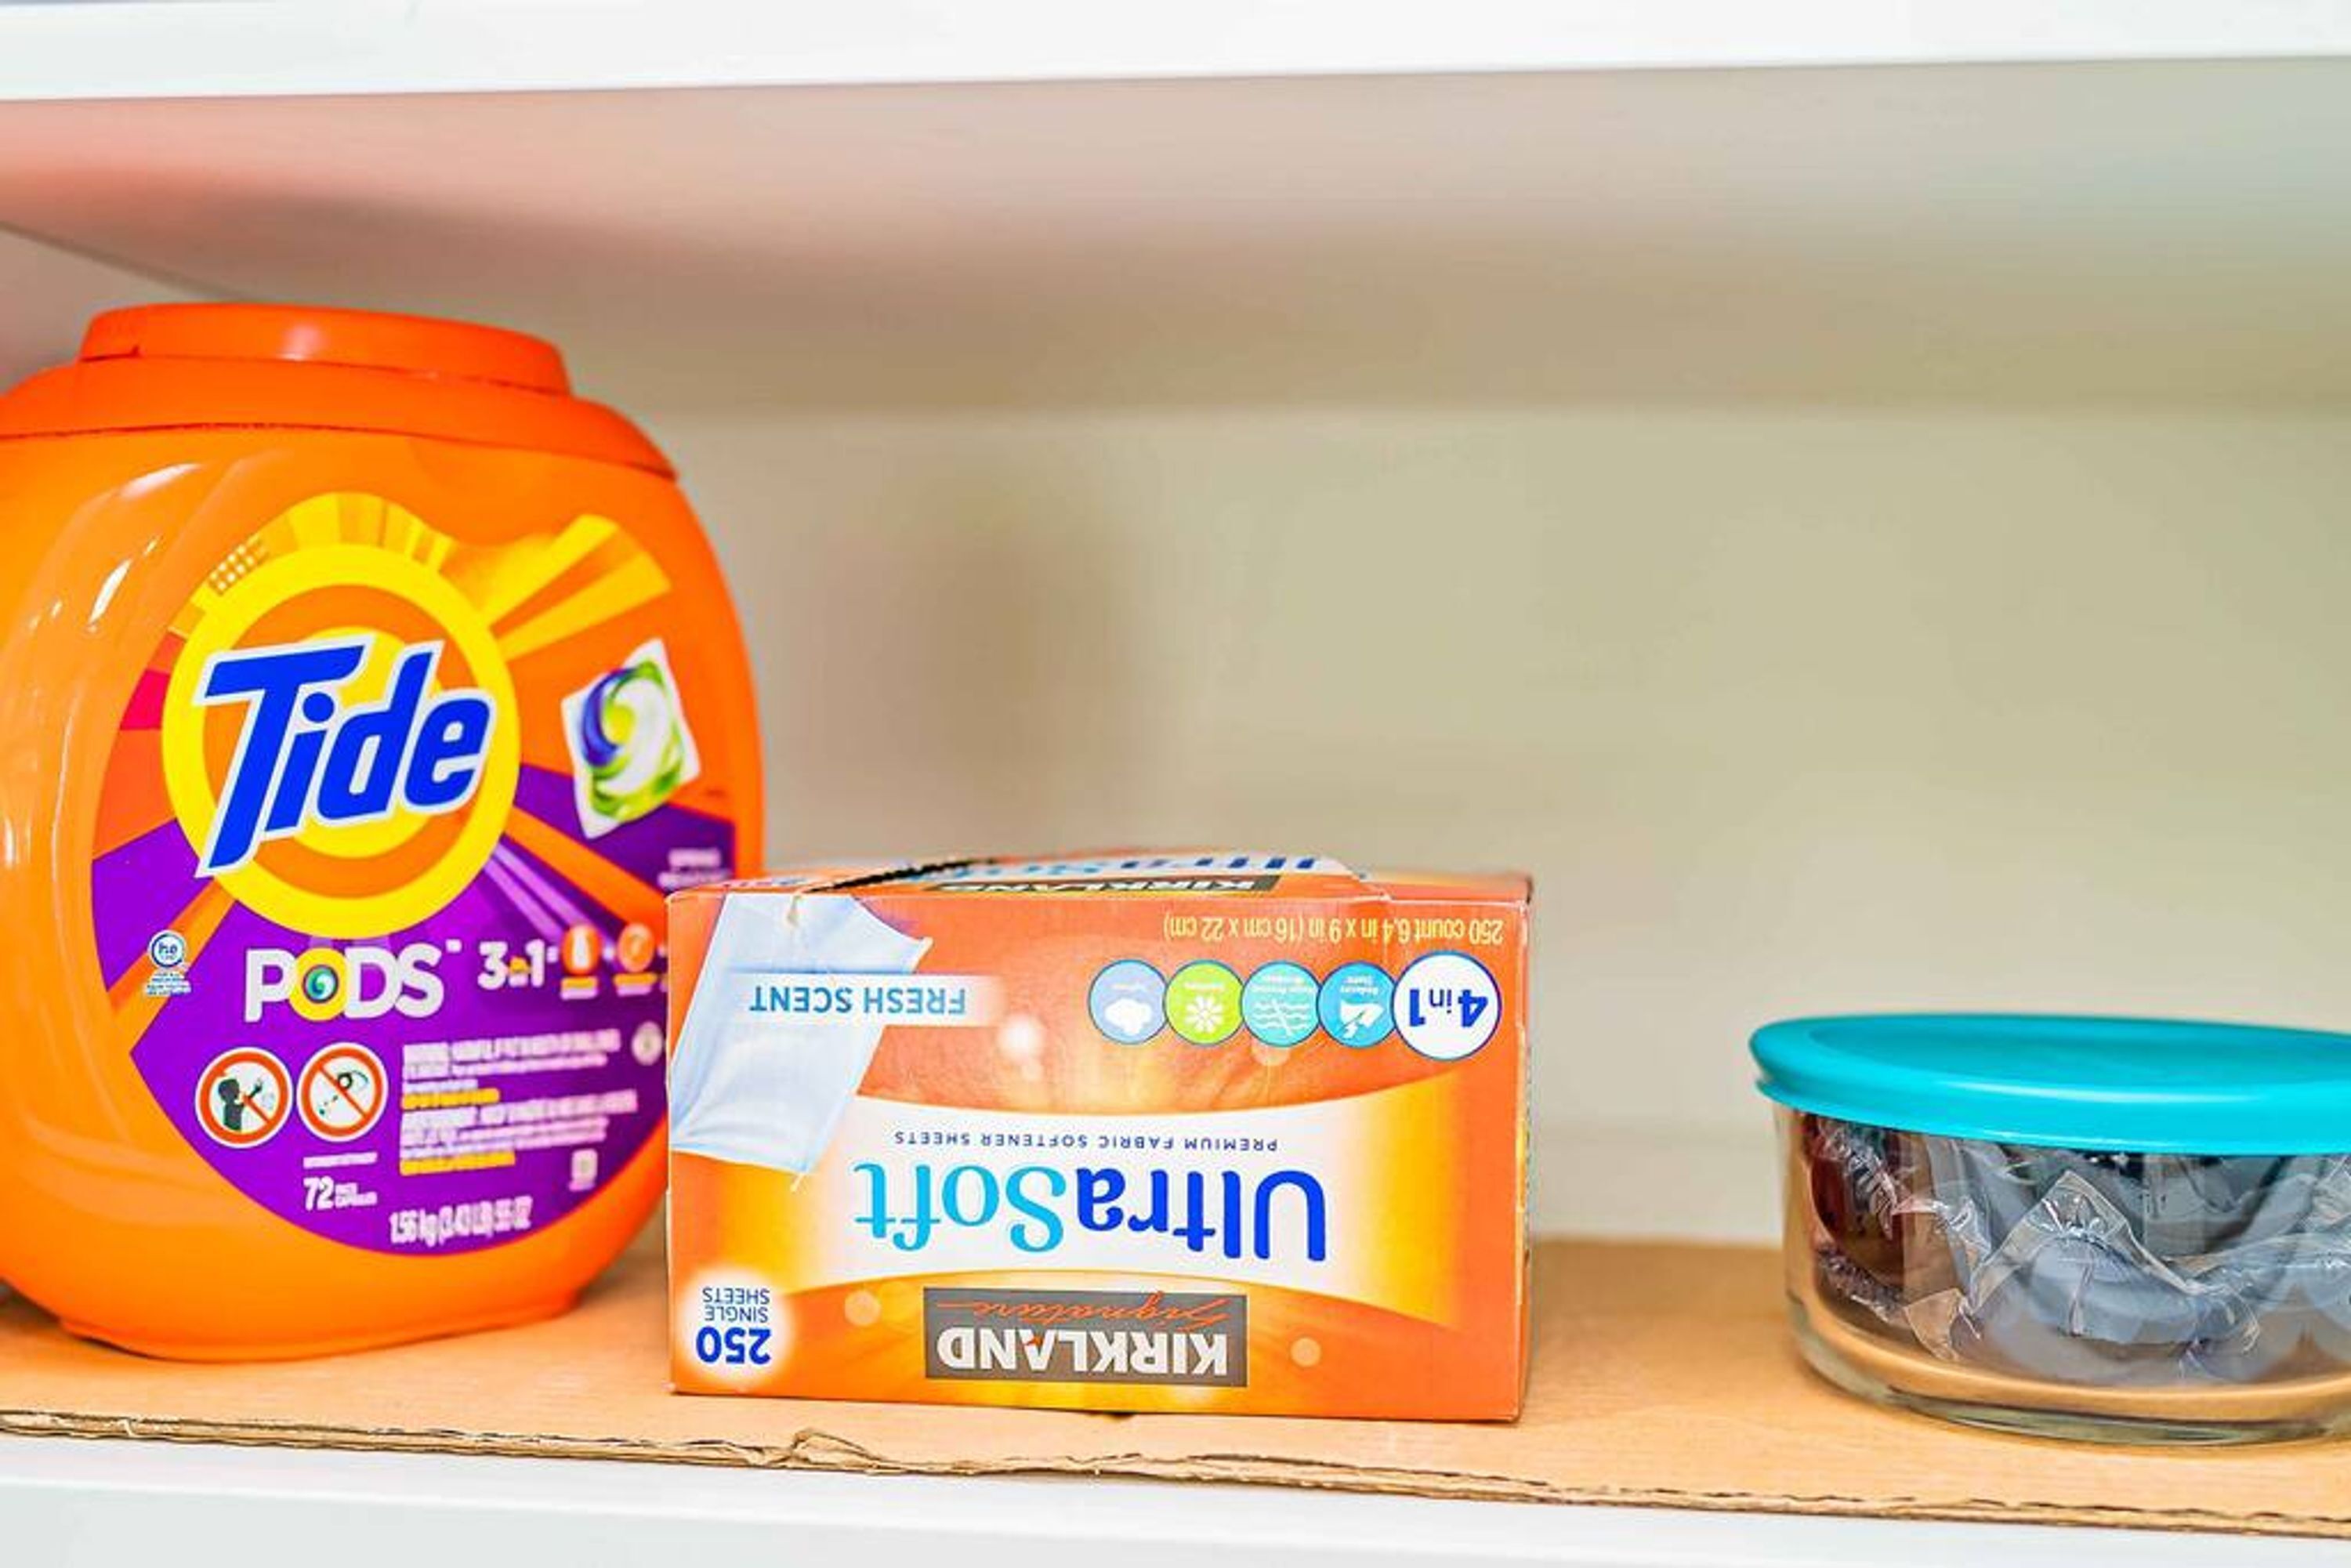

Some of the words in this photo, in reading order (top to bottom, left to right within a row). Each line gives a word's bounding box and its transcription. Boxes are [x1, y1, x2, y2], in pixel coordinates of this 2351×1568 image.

[197, 633, 495, 878] Tide
[1162, 914, 1197, 941] cm)
[1201, 917, 1223, 941] 22
[1230, 918, 1240, 935] x
[1244, 918, 1271, 935] cm
[1275, 916, 1304, 942] (16
[1308, 918, 1325, 942] in
[1331, 918, 1342, 942] 9
[1347, 918, 1357, 935] x
[1360, 918, 1378, 942] in
[1382, 918, 1411, 943] 6.4
[1415, 918, 1466, 943] count
[1469, 918, 1504, 943] 250
[245, 943, 444, 1023] PODS
[748, 986, 853, 1014] SCENT
[863, 987, 967, 1016] FRESH
[893, 1132, 970, 1146] SHEETS
[980, 1134, 1088, 1149] SOFTENER
[1098, 1135, 1174, 1150] FABRIC
[1183, 1138, 1278, 1152] PREMIUM
[303, 1175, 334, 1211] 72
[852, 1163, 1327, 1262] UltraSoft
[701, 1287, 770, 1305] SHEETS
[705, 1305, 768, 1324] SINGLE
[695, 1326, 772, 1365] 250
[936, 1327, 1228, 1376] KIRKLAND
